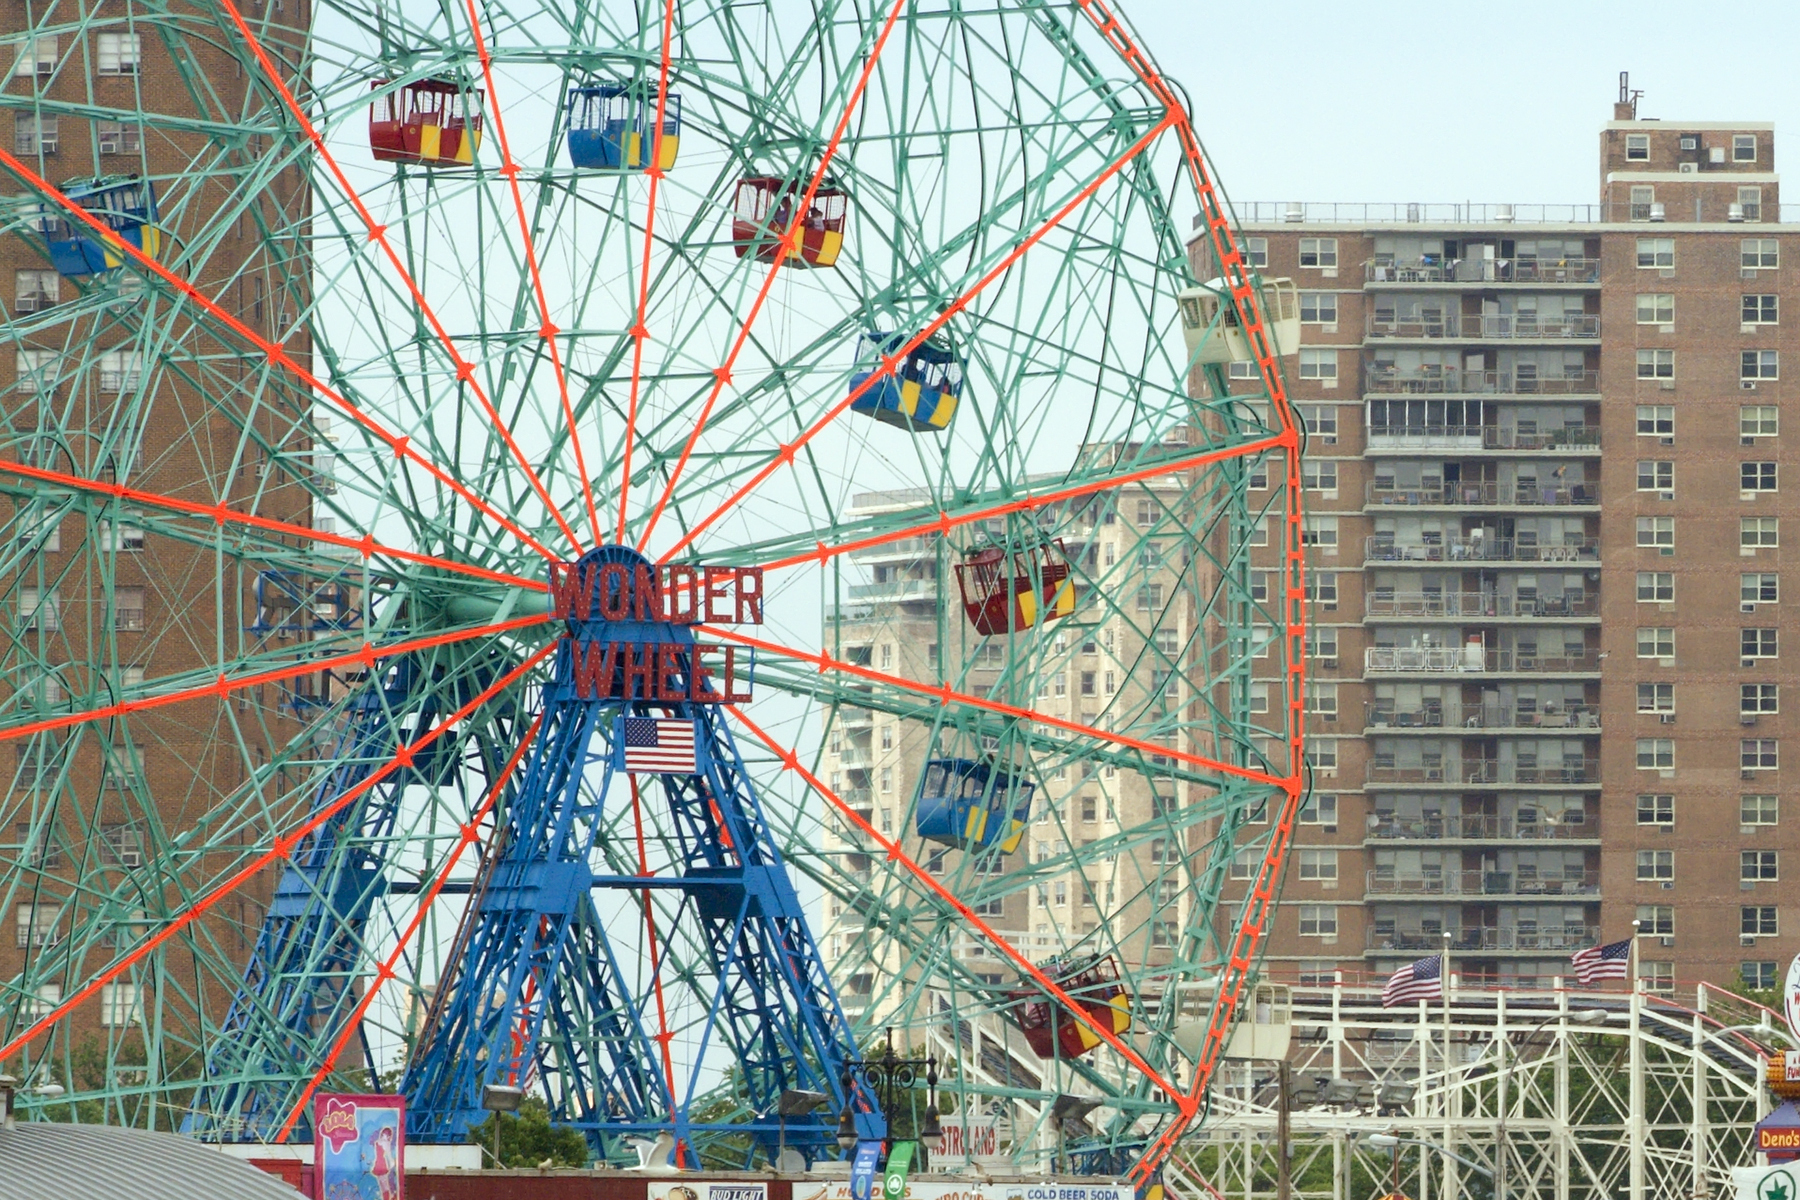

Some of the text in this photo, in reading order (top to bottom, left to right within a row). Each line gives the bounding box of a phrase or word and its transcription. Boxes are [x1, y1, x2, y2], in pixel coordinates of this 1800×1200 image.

[551, 562, 763, 624] WONDER
[572, 641, 752, 703] WHEEL
[322, 1110, 356, 1133] LOLA
[1761, 1130, 1800, 1148] Deno's
[1028, 1190, 1119, 1200] COLD BEER SODA
